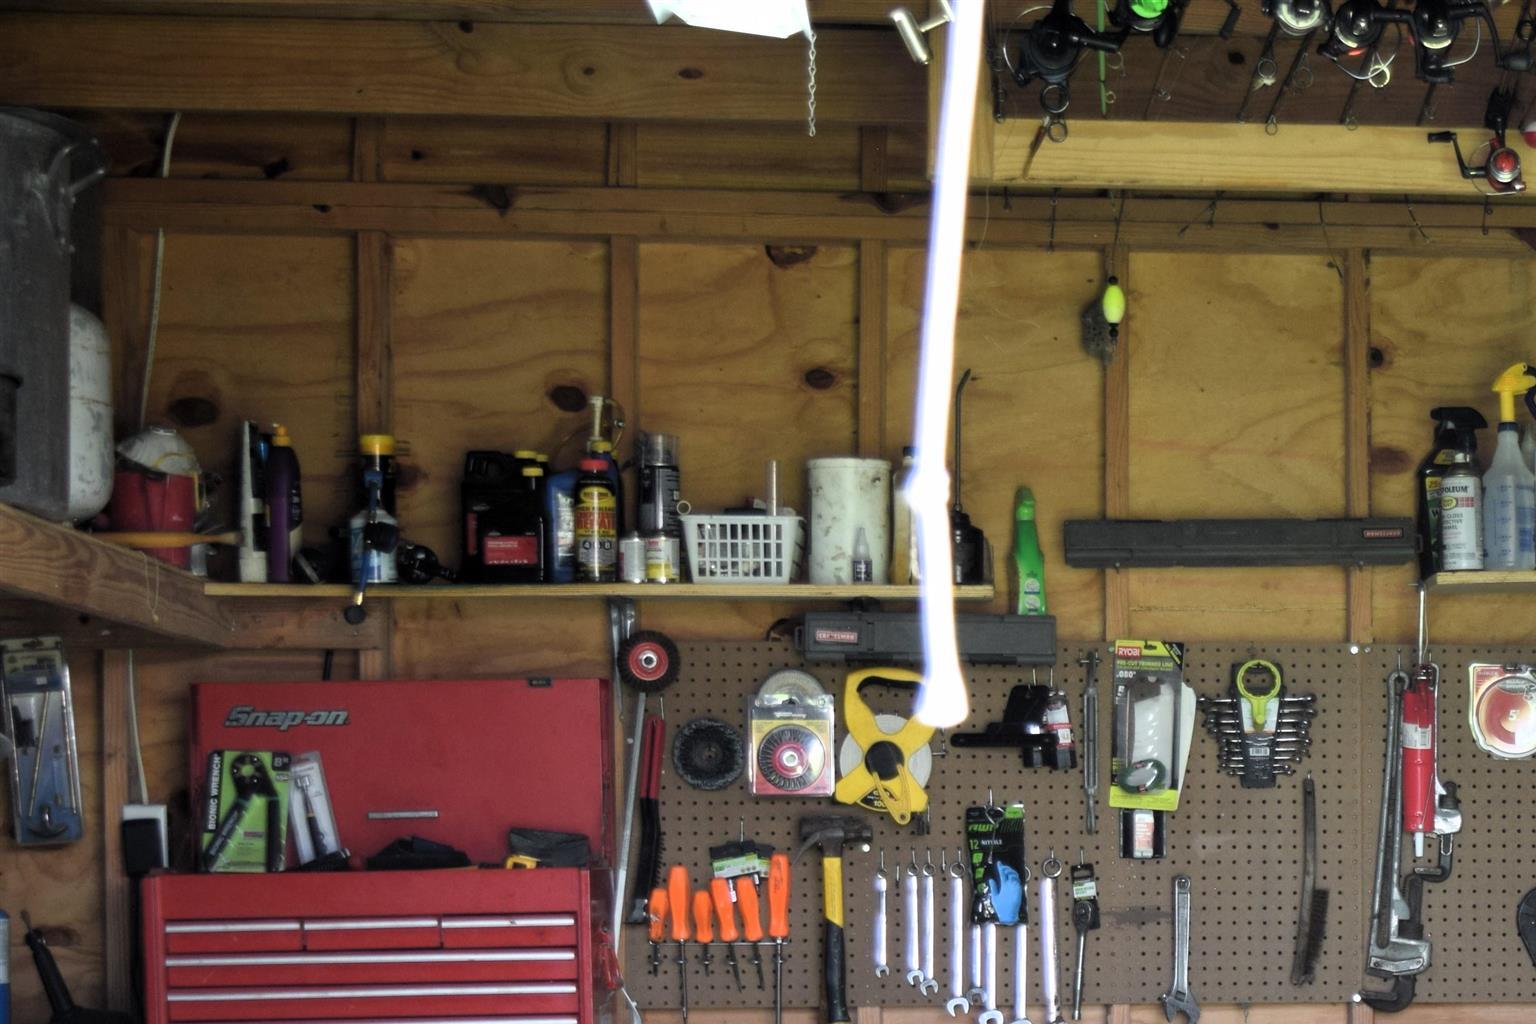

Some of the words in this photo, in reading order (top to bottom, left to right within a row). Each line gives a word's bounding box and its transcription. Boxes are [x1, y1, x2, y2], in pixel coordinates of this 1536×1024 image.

[1118, 648, 1140, 657] RYOBI
[224, 705, 349, 731] Snap-on
[210, 753, 221, 796] WRENCH
[208, 797, 218, 831] BIONIC
[969, 839, 980, 850] 12
